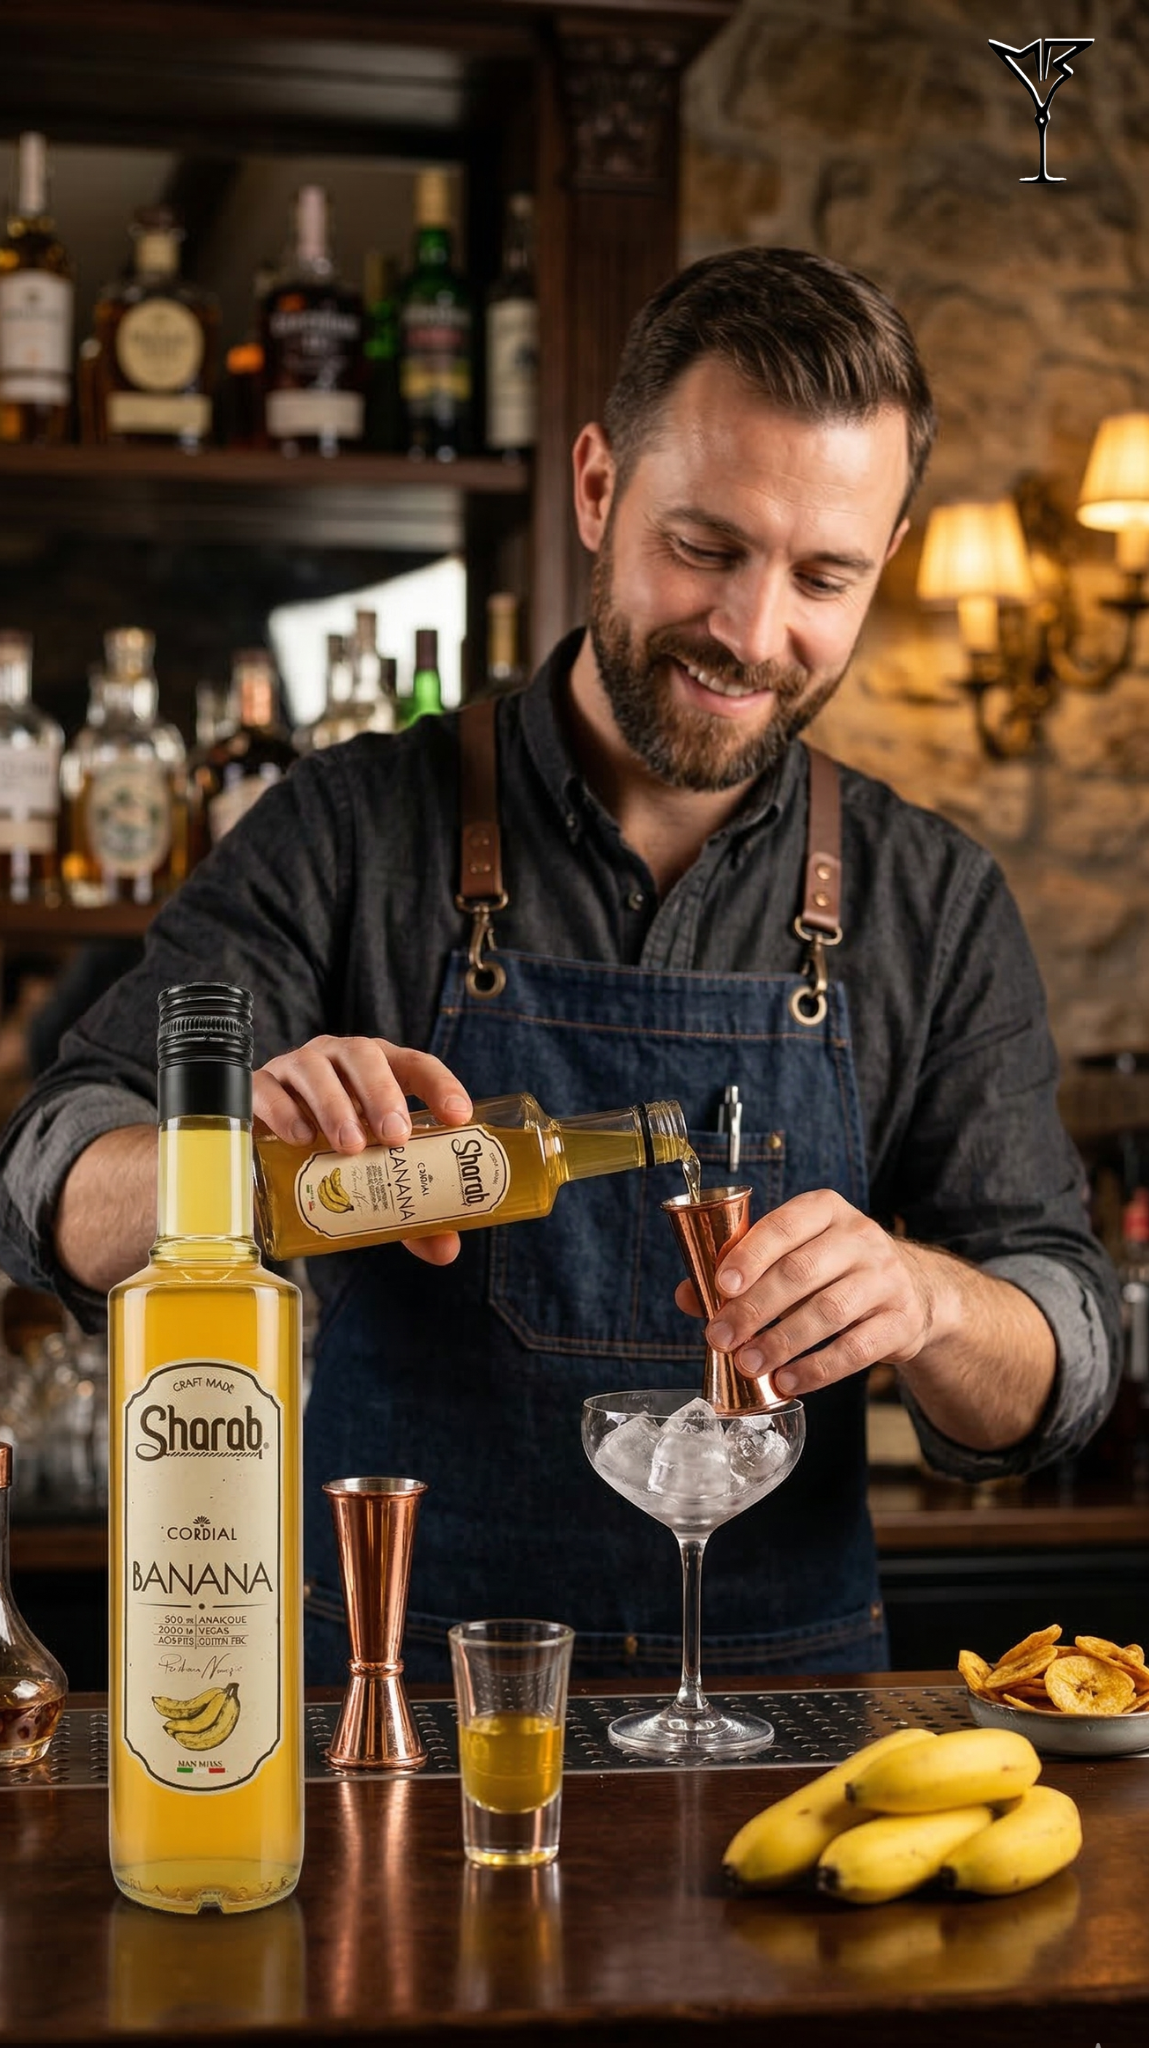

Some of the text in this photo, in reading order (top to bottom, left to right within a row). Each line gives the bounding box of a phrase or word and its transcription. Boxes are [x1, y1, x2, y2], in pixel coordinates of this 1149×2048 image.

[451, 1139, 490, 1205] Sharab
[173, 1377, 202, 1392] CRAFT
[135, 1405, 263, 1462] Sharab
[167, 1527, 237, 1541] CORDIAL
[132, 1561, 273, 1596] BANANA
[164, 1615, 183, 1624] 500
[158, 1625, 183, 1634] 2000
[198, 1627, 230, 1635] VEGAS
